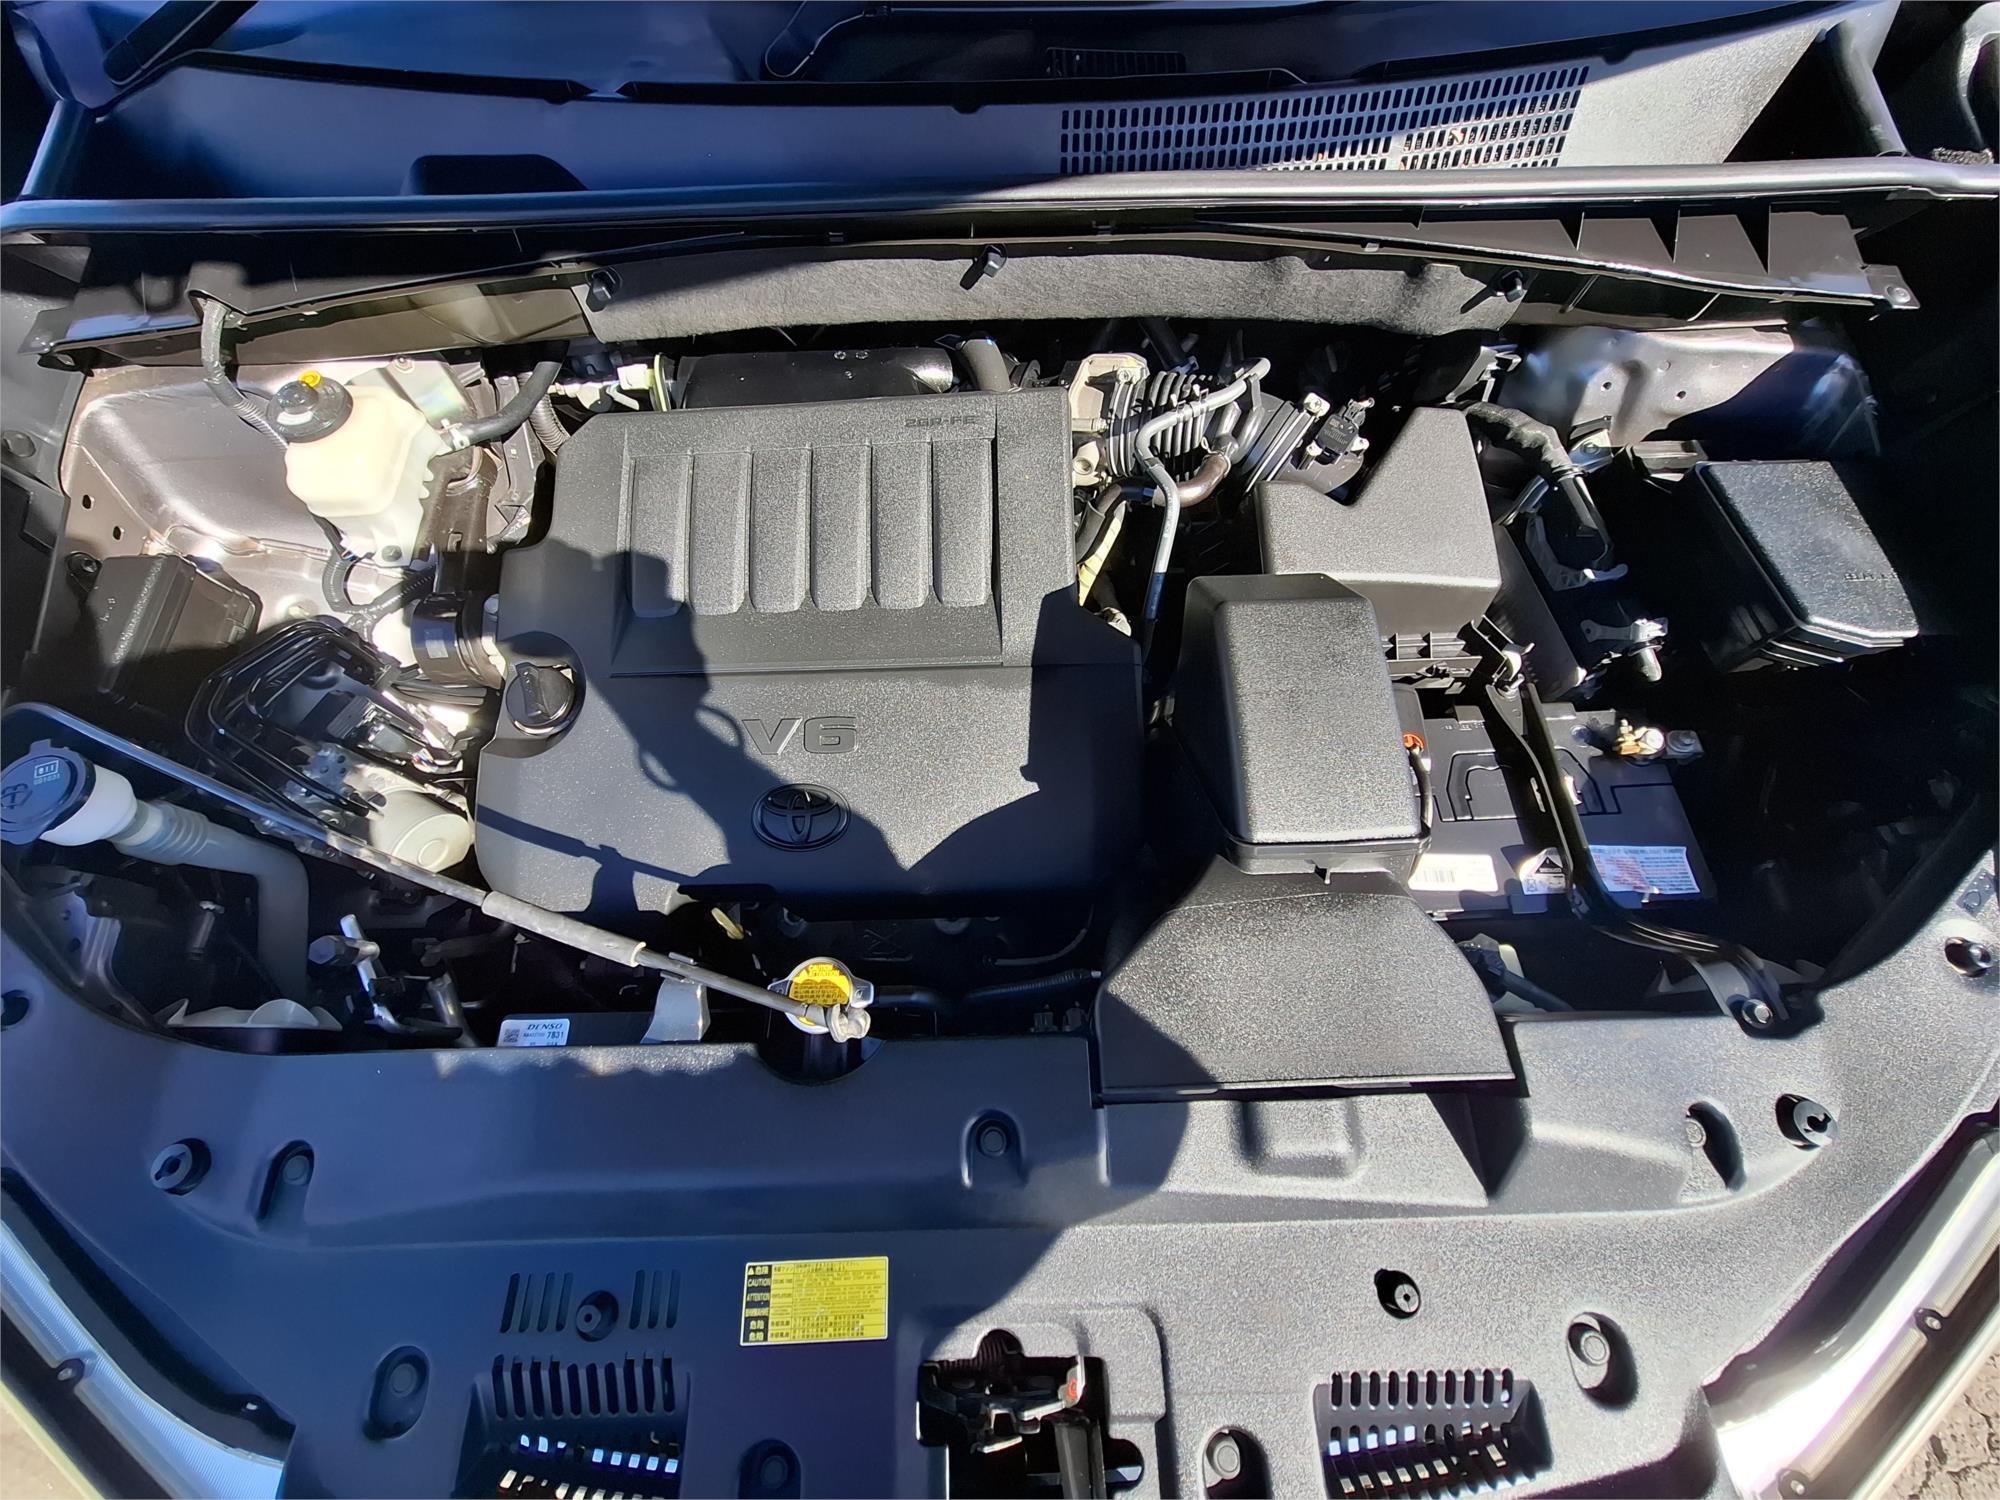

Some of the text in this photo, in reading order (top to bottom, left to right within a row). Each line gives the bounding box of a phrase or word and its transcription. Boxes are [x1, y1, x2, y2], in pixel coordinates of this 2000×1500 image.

[904, 415, 978, 427] 2GR-FE
[741, 716, 858, 756] V6
[747, 1278, 771, 1287] CAUTION
[746, 1293, 770, 1302] ATTENTION
